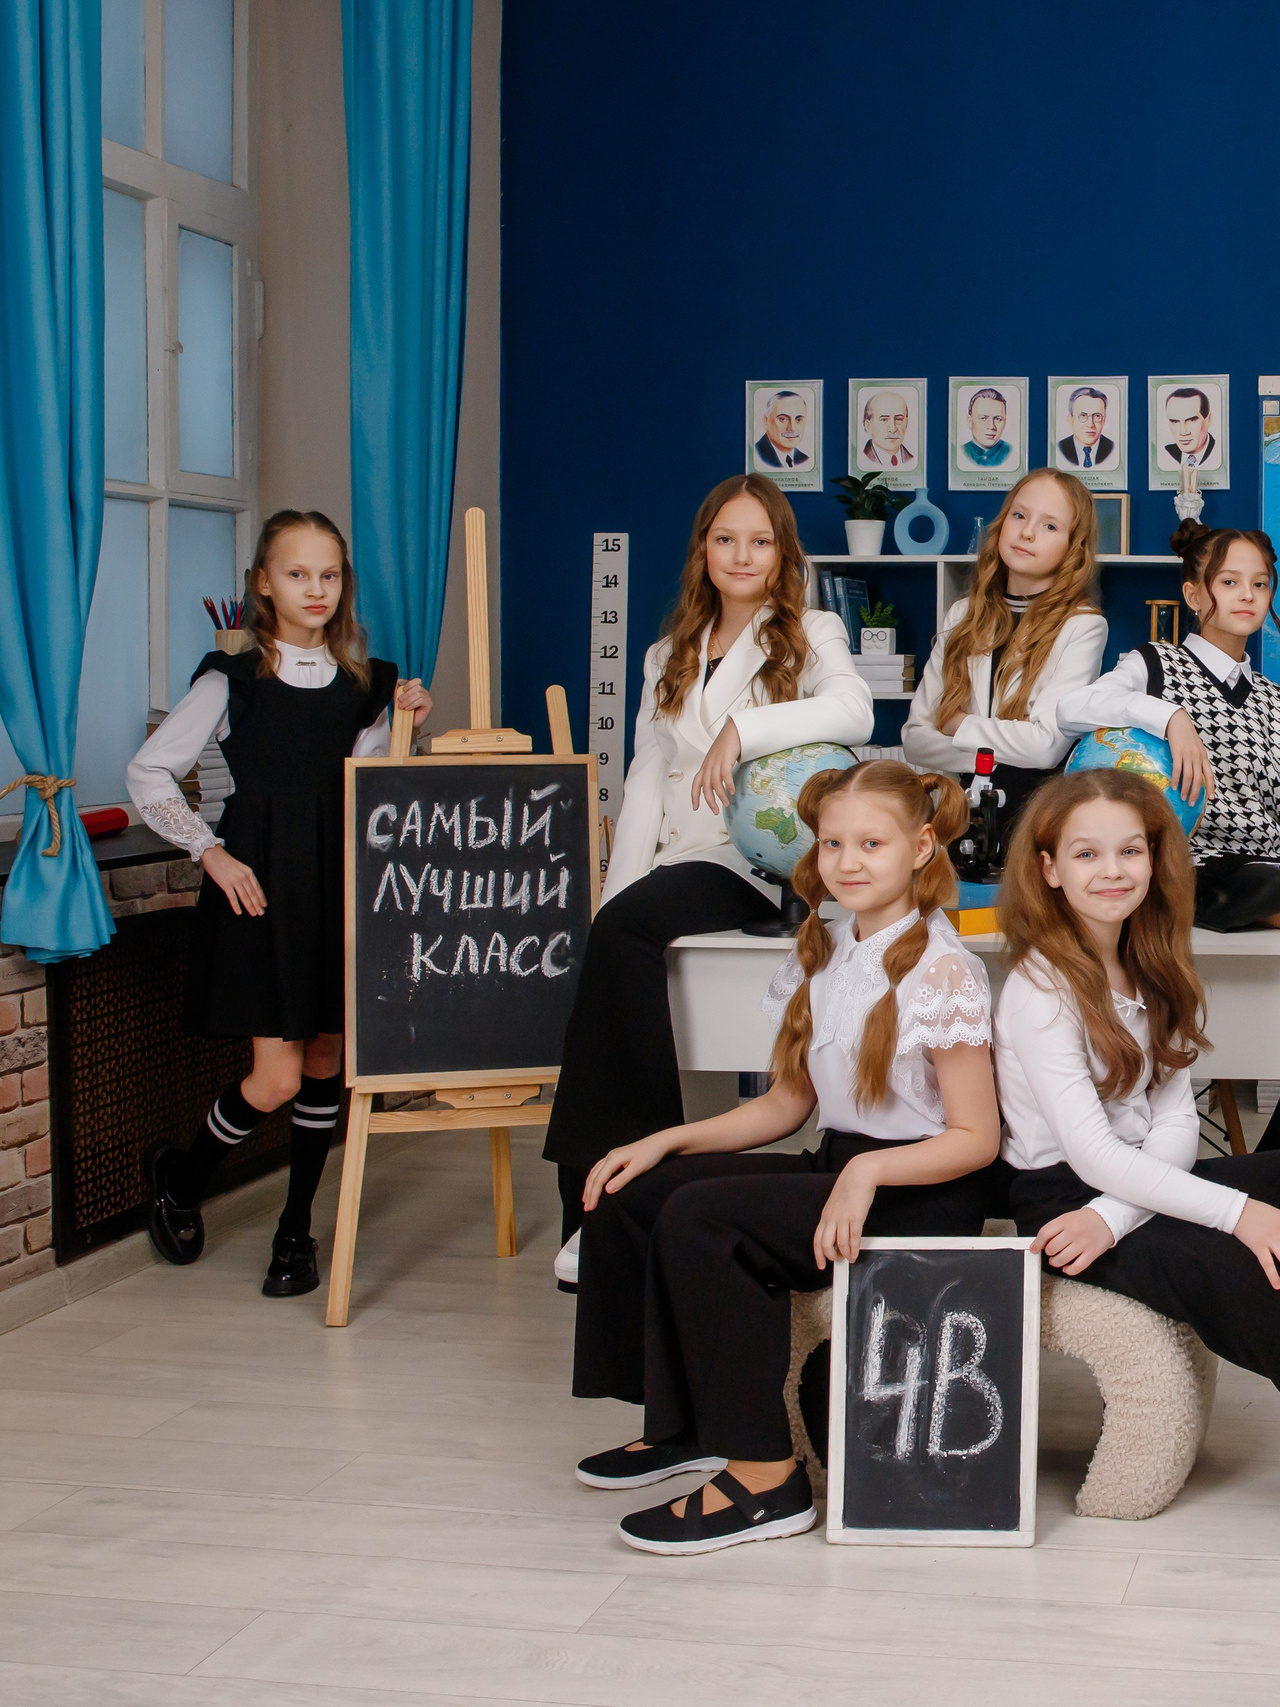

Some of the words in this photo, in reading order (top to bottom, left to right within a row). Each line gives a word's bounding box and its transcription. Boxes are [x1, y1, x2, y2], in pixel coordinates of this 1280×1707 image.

[602, 538, 621, 552] 15
[602, 574, 619, 588] 14
[600, 610, 618, 624] 13
[600, 645, 619, 659] 12
[598, 681, 616, 695] 11
[597, 716, 615, 730] 10
[599, 752, 609, 765] 9
[599, 788, 609, 801] 8
[366, 783, 561, 850] САМЫЙ
[373, 852, 571, 914] ЛУЧШИЙ
[410, 931, 572, 981] КЛАСС
